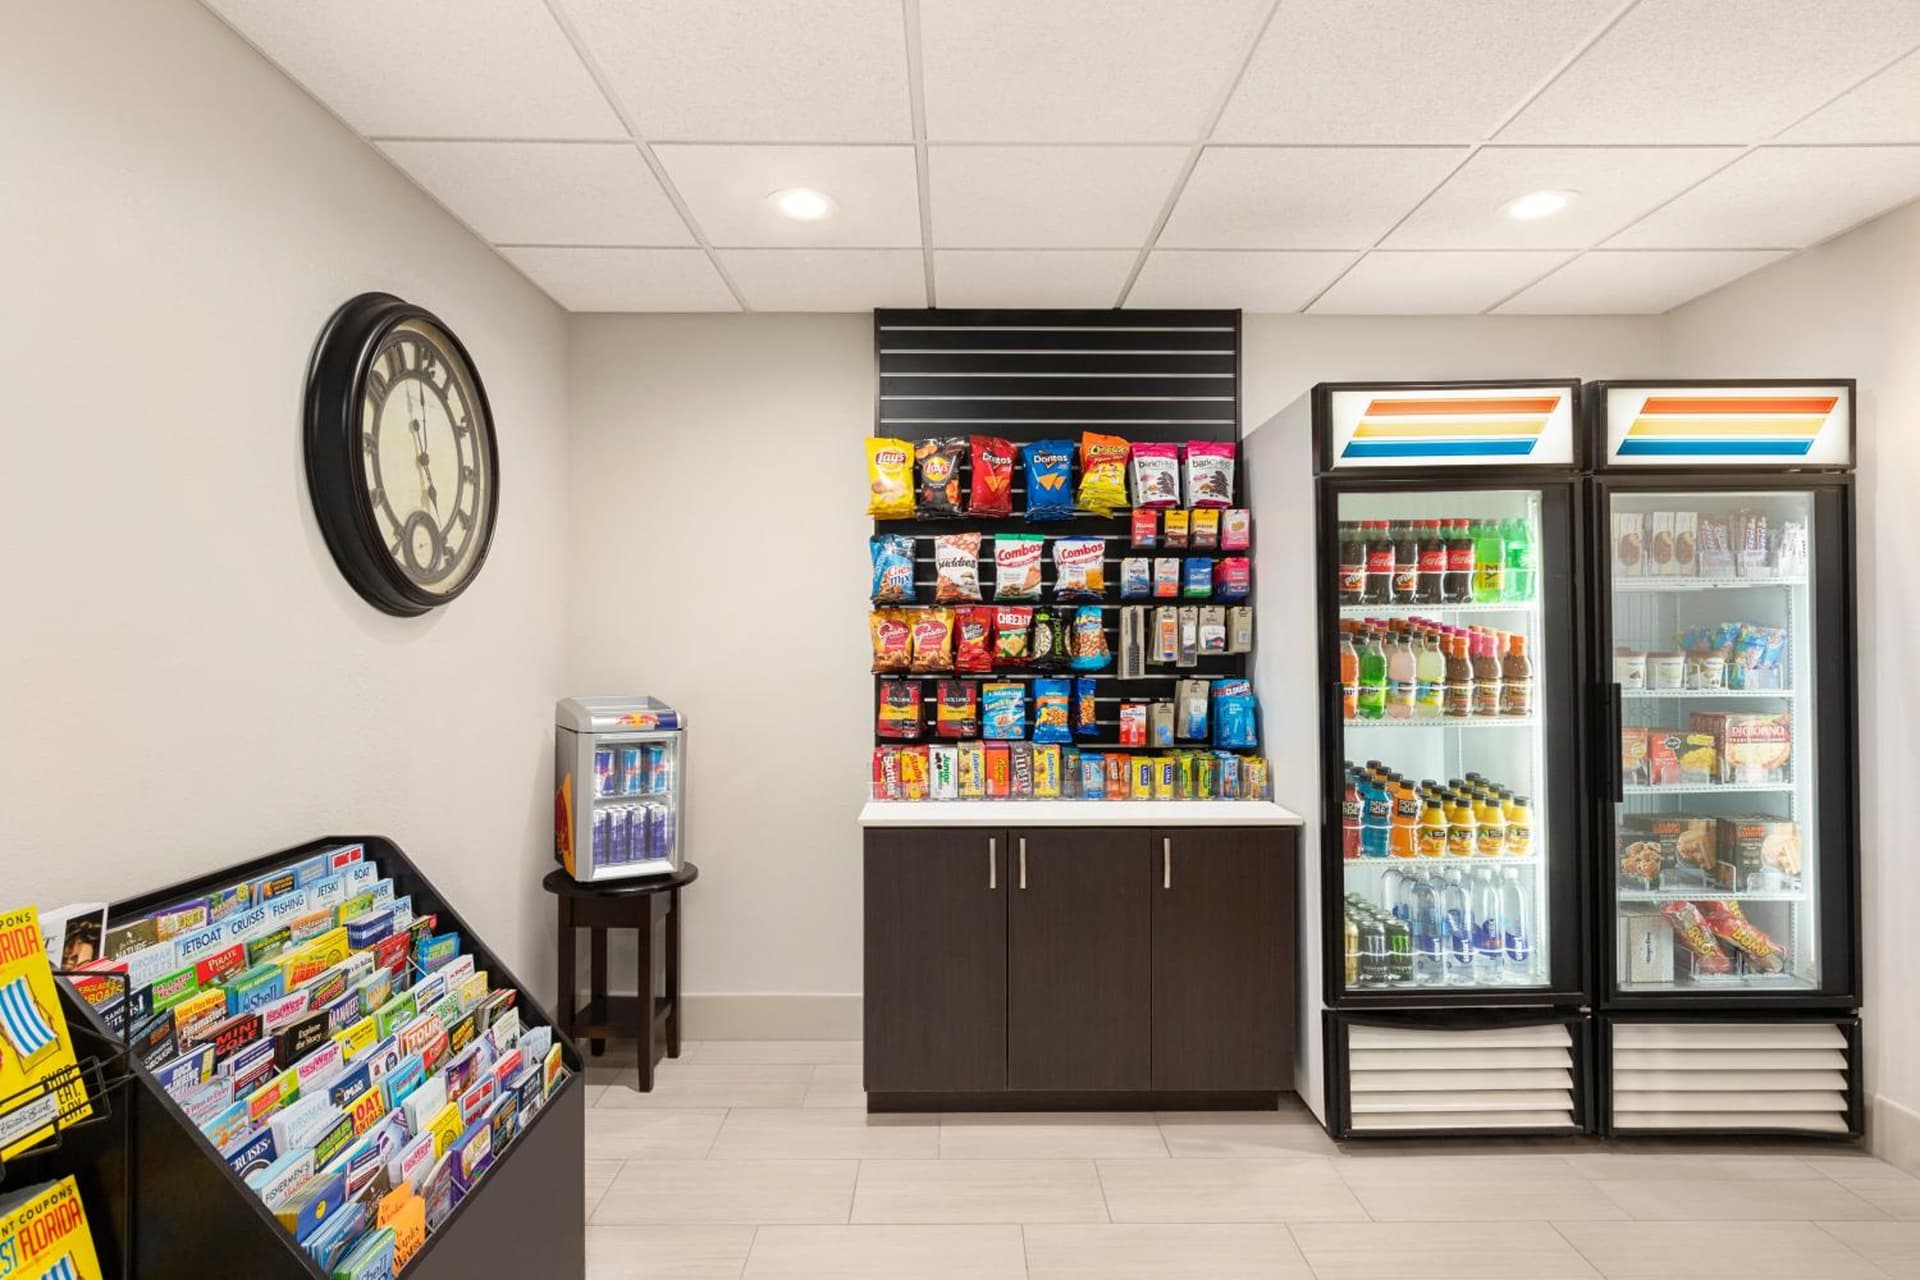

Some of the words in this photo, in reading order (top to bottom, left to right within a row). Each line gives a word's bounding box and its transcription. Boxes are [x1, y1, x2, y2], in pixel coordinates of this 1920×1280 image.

[998, 543, 1042, 561] Combos
[1062, 542, 1104, 560] Combos
[883, 755, 896, 797] Skittles
[943, 753, 952, 784] Junior
[1141, 765, 1149, 785] LUNA
[316, 881, 339, 898] JETSKI
[272, 894, 305, 917] FISHING
[231, 908, 265, 935] CRUISES
[182, 928, 222, 956] JETBOAT
[207, 949, 238, 973] PIRATE
[249, 983, 278, 1011] Shell
[216, 1017, 259, 1045] MINI
[216, 1029, 257, 1057] GOLF
[355, 1089, 381, 1122] OAT
[354, 1104, 385, 1136] ENTALS
[19, 1184, 74, 1225] COUPONS
[18, 1197, 83, 1261] FLORIDA
